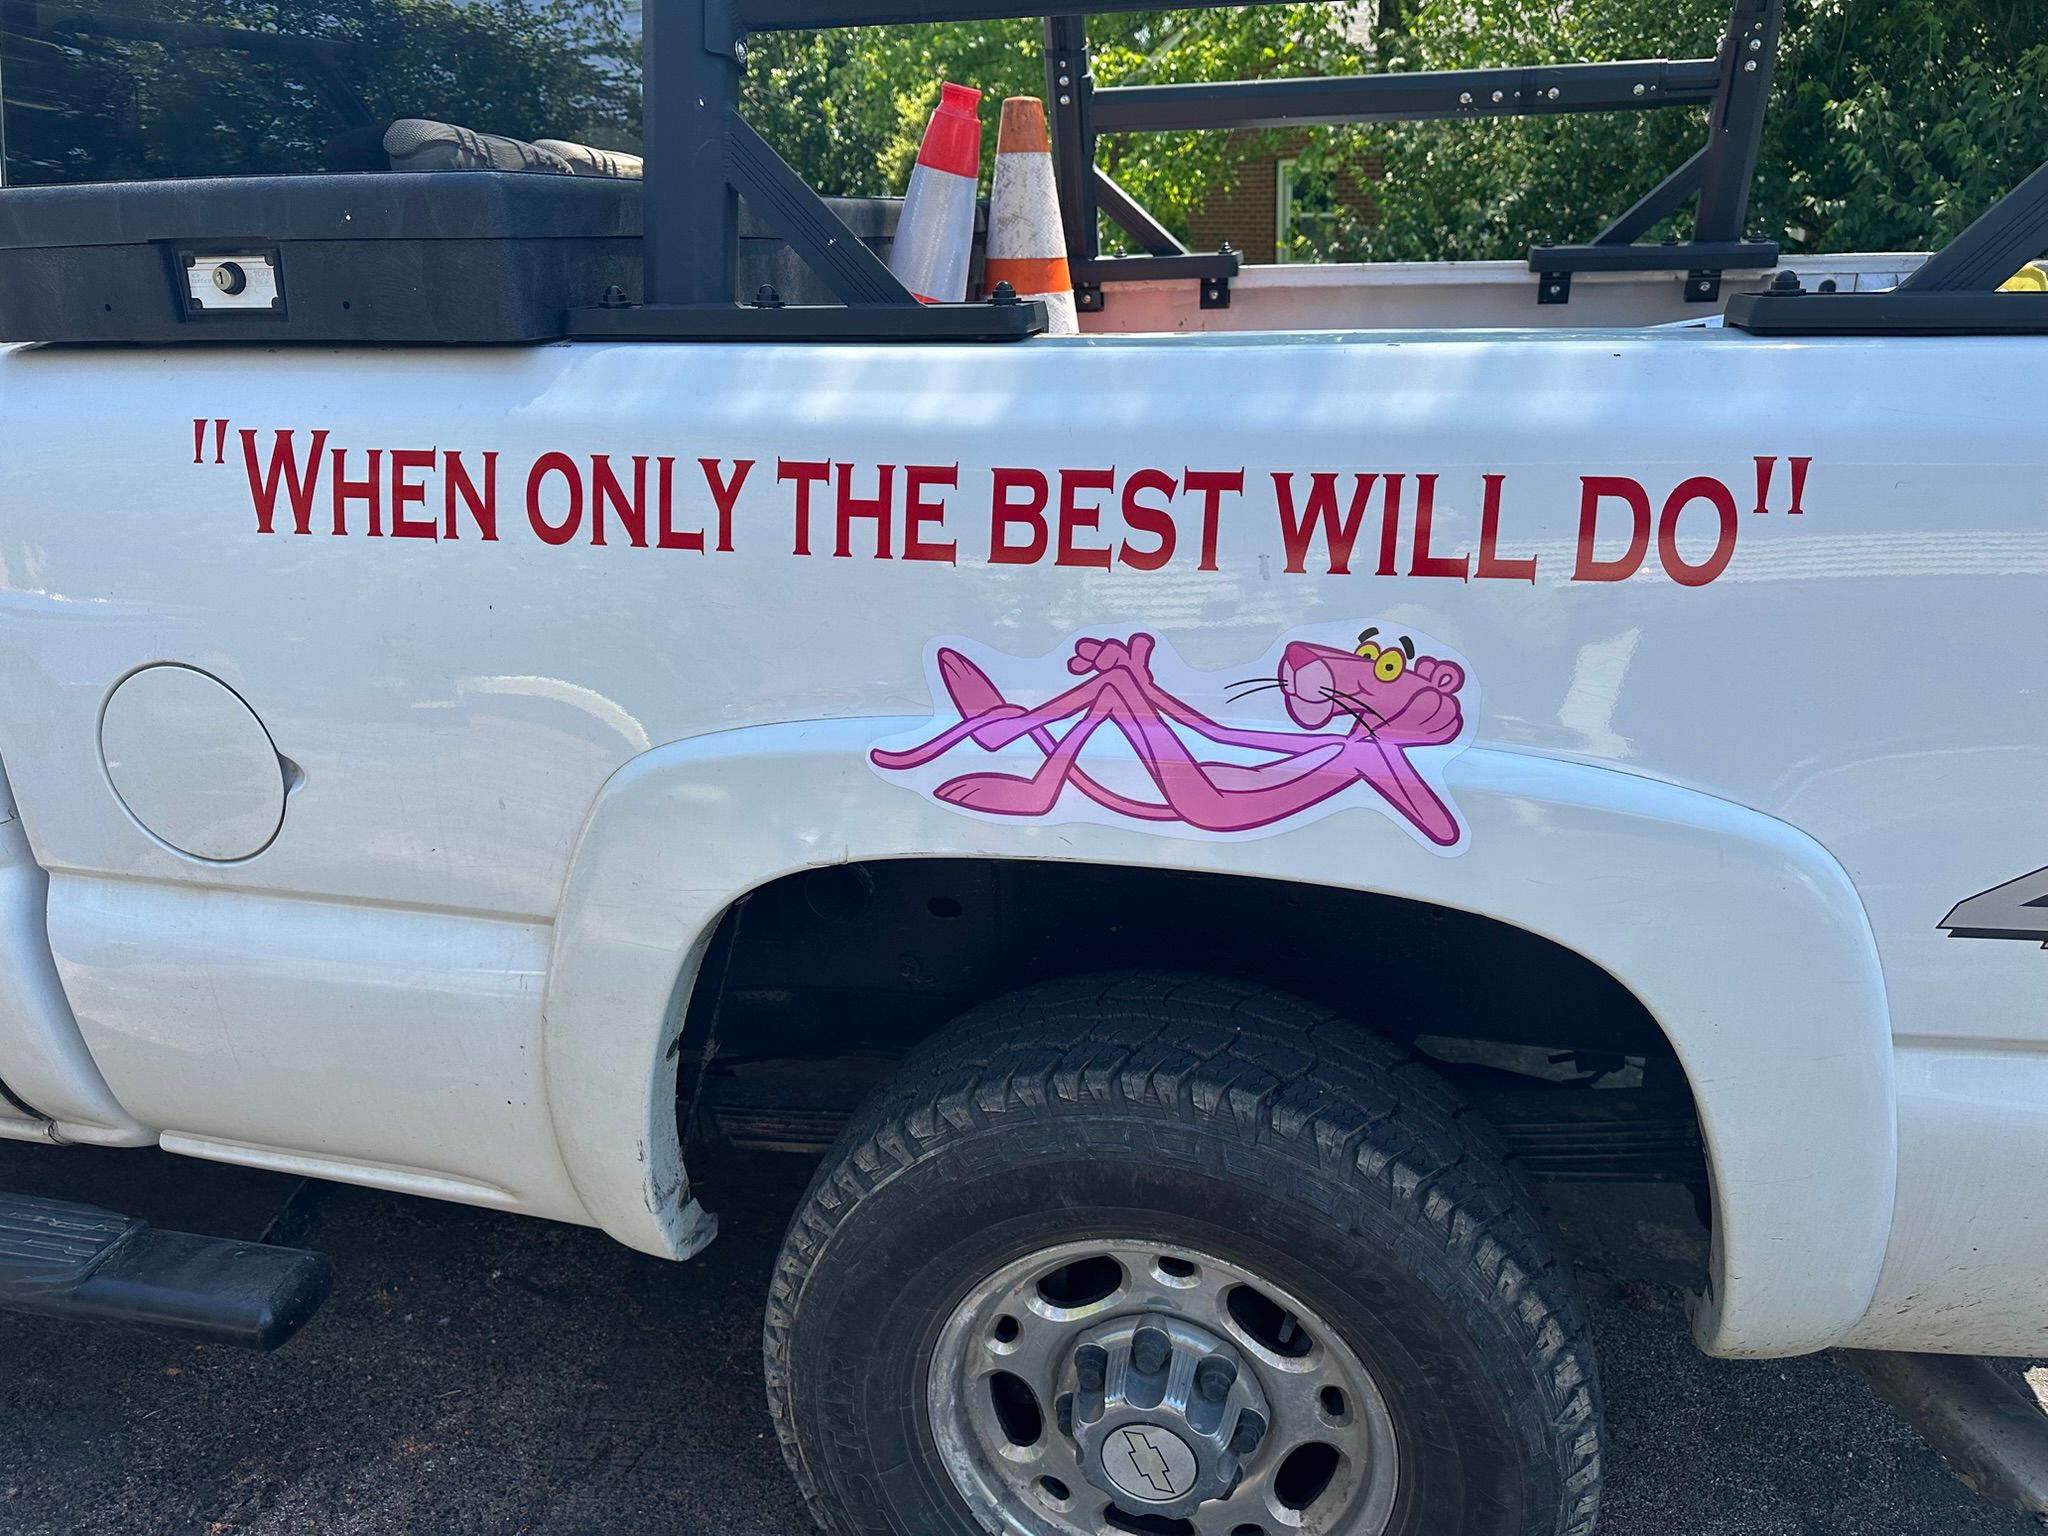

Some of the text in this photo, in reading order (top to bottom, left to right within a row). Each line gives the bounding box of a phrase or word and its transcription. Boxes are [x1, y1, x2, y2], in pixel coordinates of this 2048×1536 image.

[526, 450, 757, 556] ONLY
[776, 456, 960, 567] THE
[987, 465, 1245, 573] BEST
[1270, 472, 1538, 586] WILL
